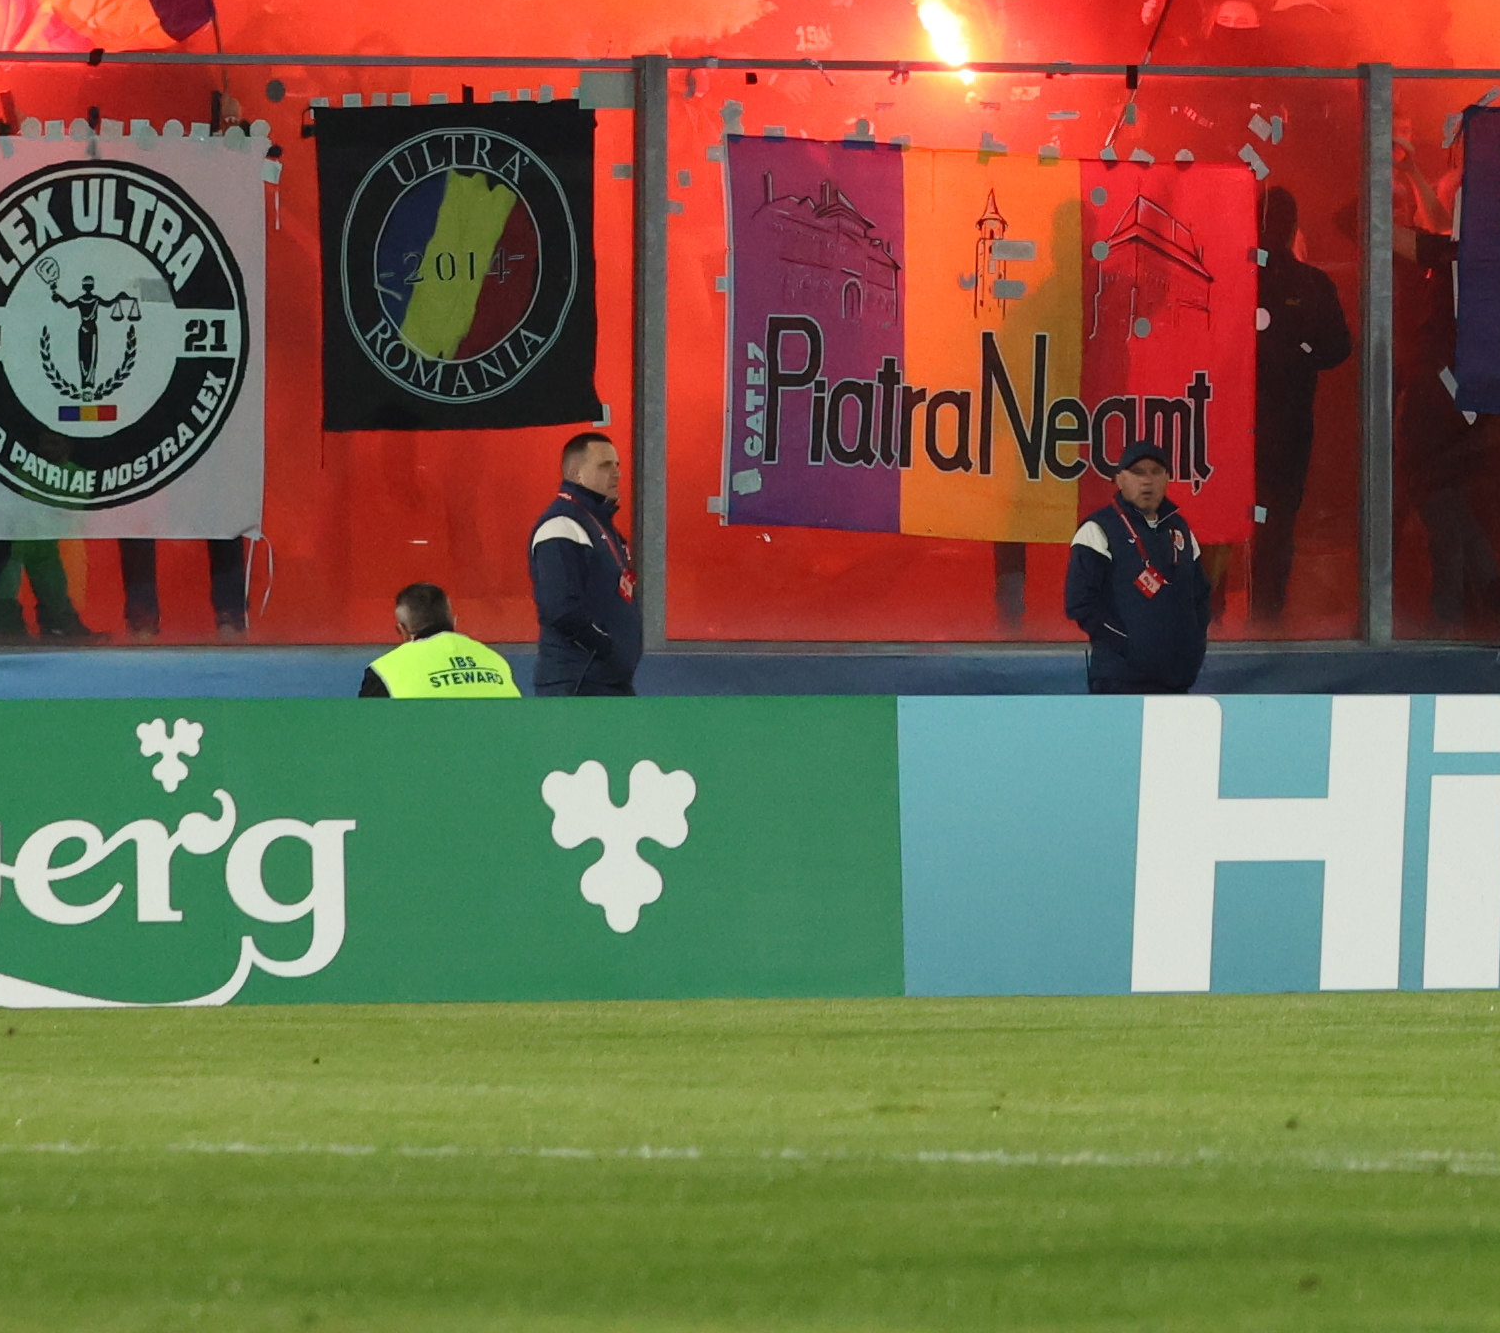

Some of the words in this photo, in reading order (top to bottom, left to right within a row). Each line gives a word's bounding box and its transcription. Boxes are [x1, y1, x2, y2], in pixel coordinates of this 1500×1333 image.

[70, 177, 205, 293] ULTRA
[184, 318, 229, 353] 21
[364, 318, 546, 396] ROMANIA
[9, 446, 97, 494] PATRIAE
[101, 422, 197, 494] NOSTRA
[193, 370, 228, 426] LEX
[429, 671, 505, 689] STEWARD
